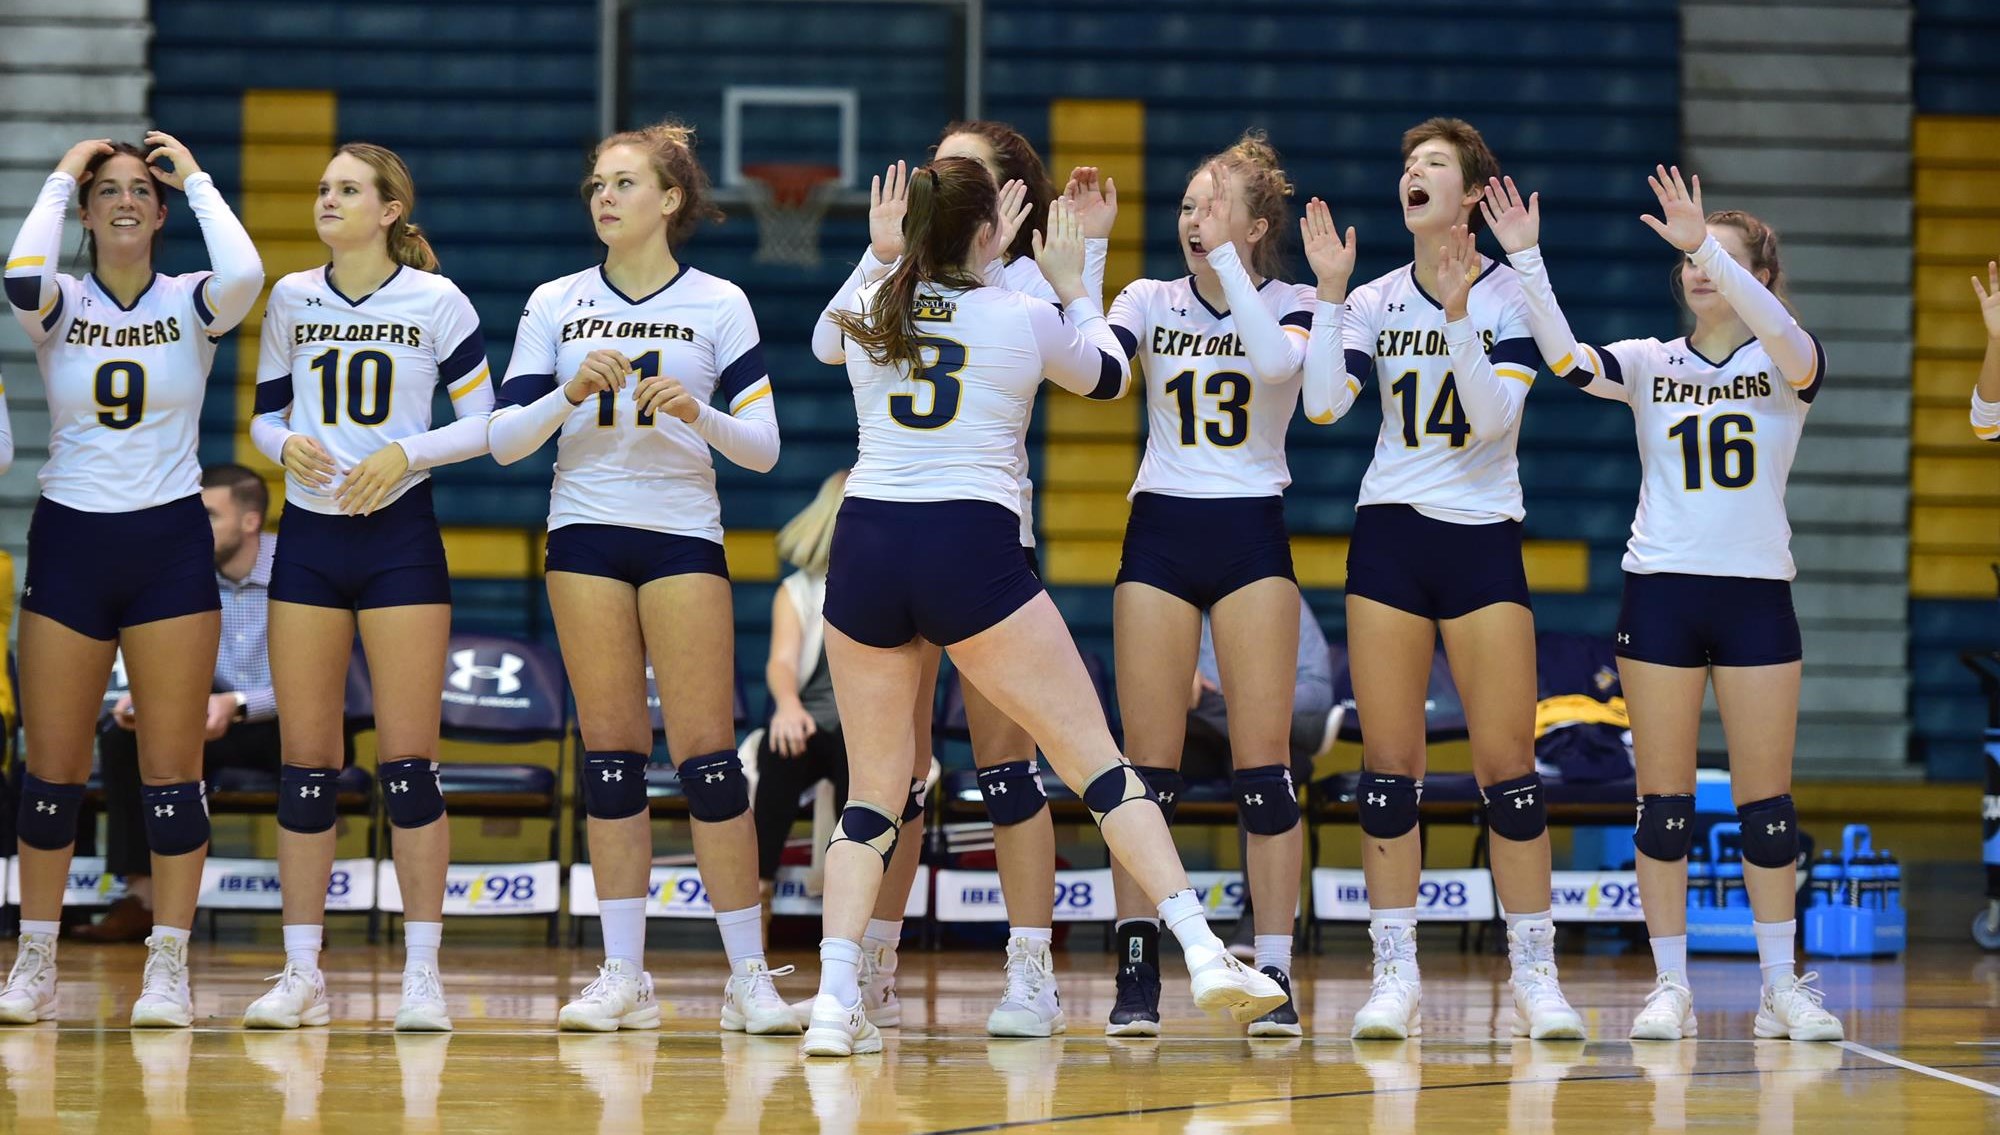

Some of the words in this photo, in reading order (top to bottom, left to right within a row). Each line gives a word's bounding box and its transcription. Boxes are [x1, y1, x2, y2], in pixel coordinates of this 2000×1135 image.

[65, 316, 181, 348] EXPLORERS
[295, 323, 421, 348] EXPLORERS
[562, 319, 694, 343] EXPLORERS
[1152, 325, 1246, 357] EXPLORE
[1376, 329, 1494, 357] EXPLORS
[93, 359, 148, 430] 9
[309, 347, 395, 426] 10
[888, 334, 968, 431] 3
[1164, 369, 1253, 448] 13
[1391, 370, 1473, 448] 14
[1668, 412, 1756, 492] 16
[219, 875, 281, 892] IBEW
[326, 871, 350, 896] 8
[486, 875, 534, 901] 98
[961, 888, 1000, 904] IBE
[1418, 881, 1467, 908] 98
[1551, 888, 1585, 904] EW
